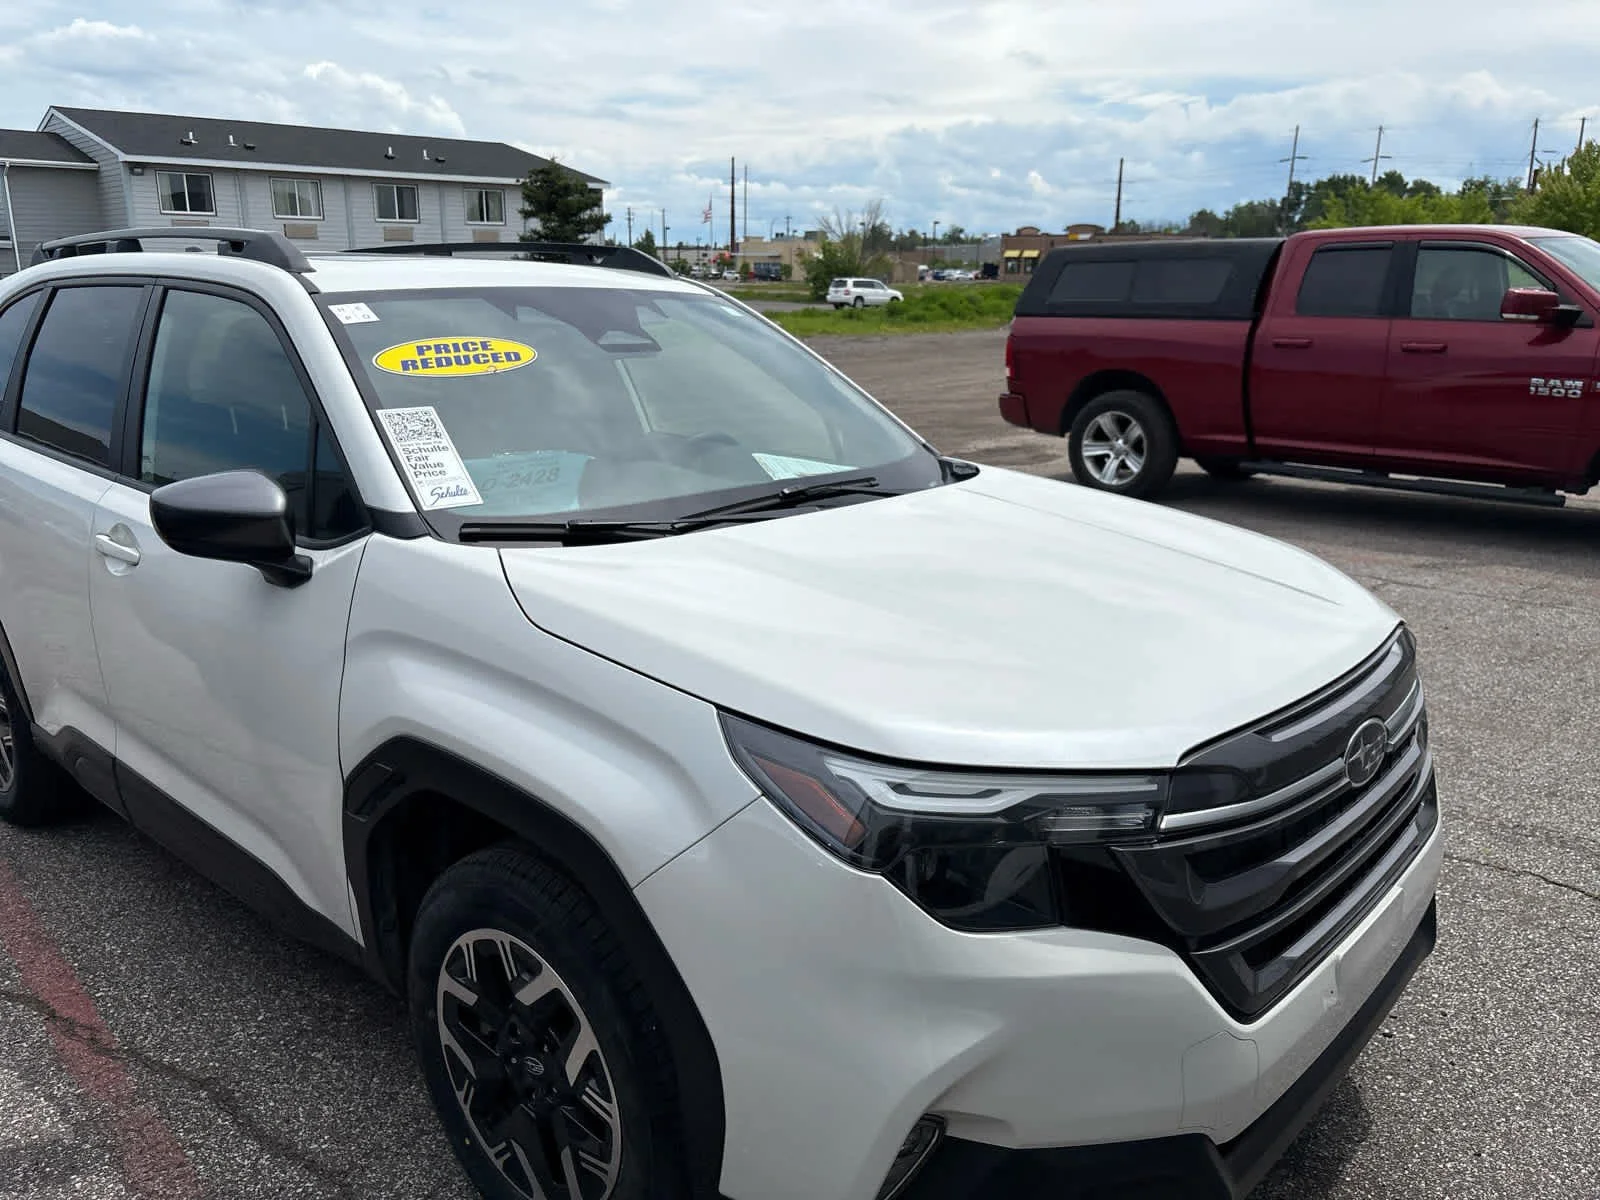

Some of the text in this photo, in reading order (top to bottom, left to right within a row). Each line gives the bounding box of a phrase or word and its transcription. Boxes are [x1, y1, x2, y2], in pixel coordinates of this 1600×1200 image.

[416, 340, 494, 356] PRICE
[400, 351, 521, 371] REDUCED
[1530, 377, 1584, 389] RAM
[1529, 386, 1582, 398] 1500
[402, 444, 449, 455] Schulte
[406, 454, 430, 463] Fair
[409, 461, 445, 470] Value
[413, 469, 447, 478] Price
[430, 484, 468, 505] Schulte
